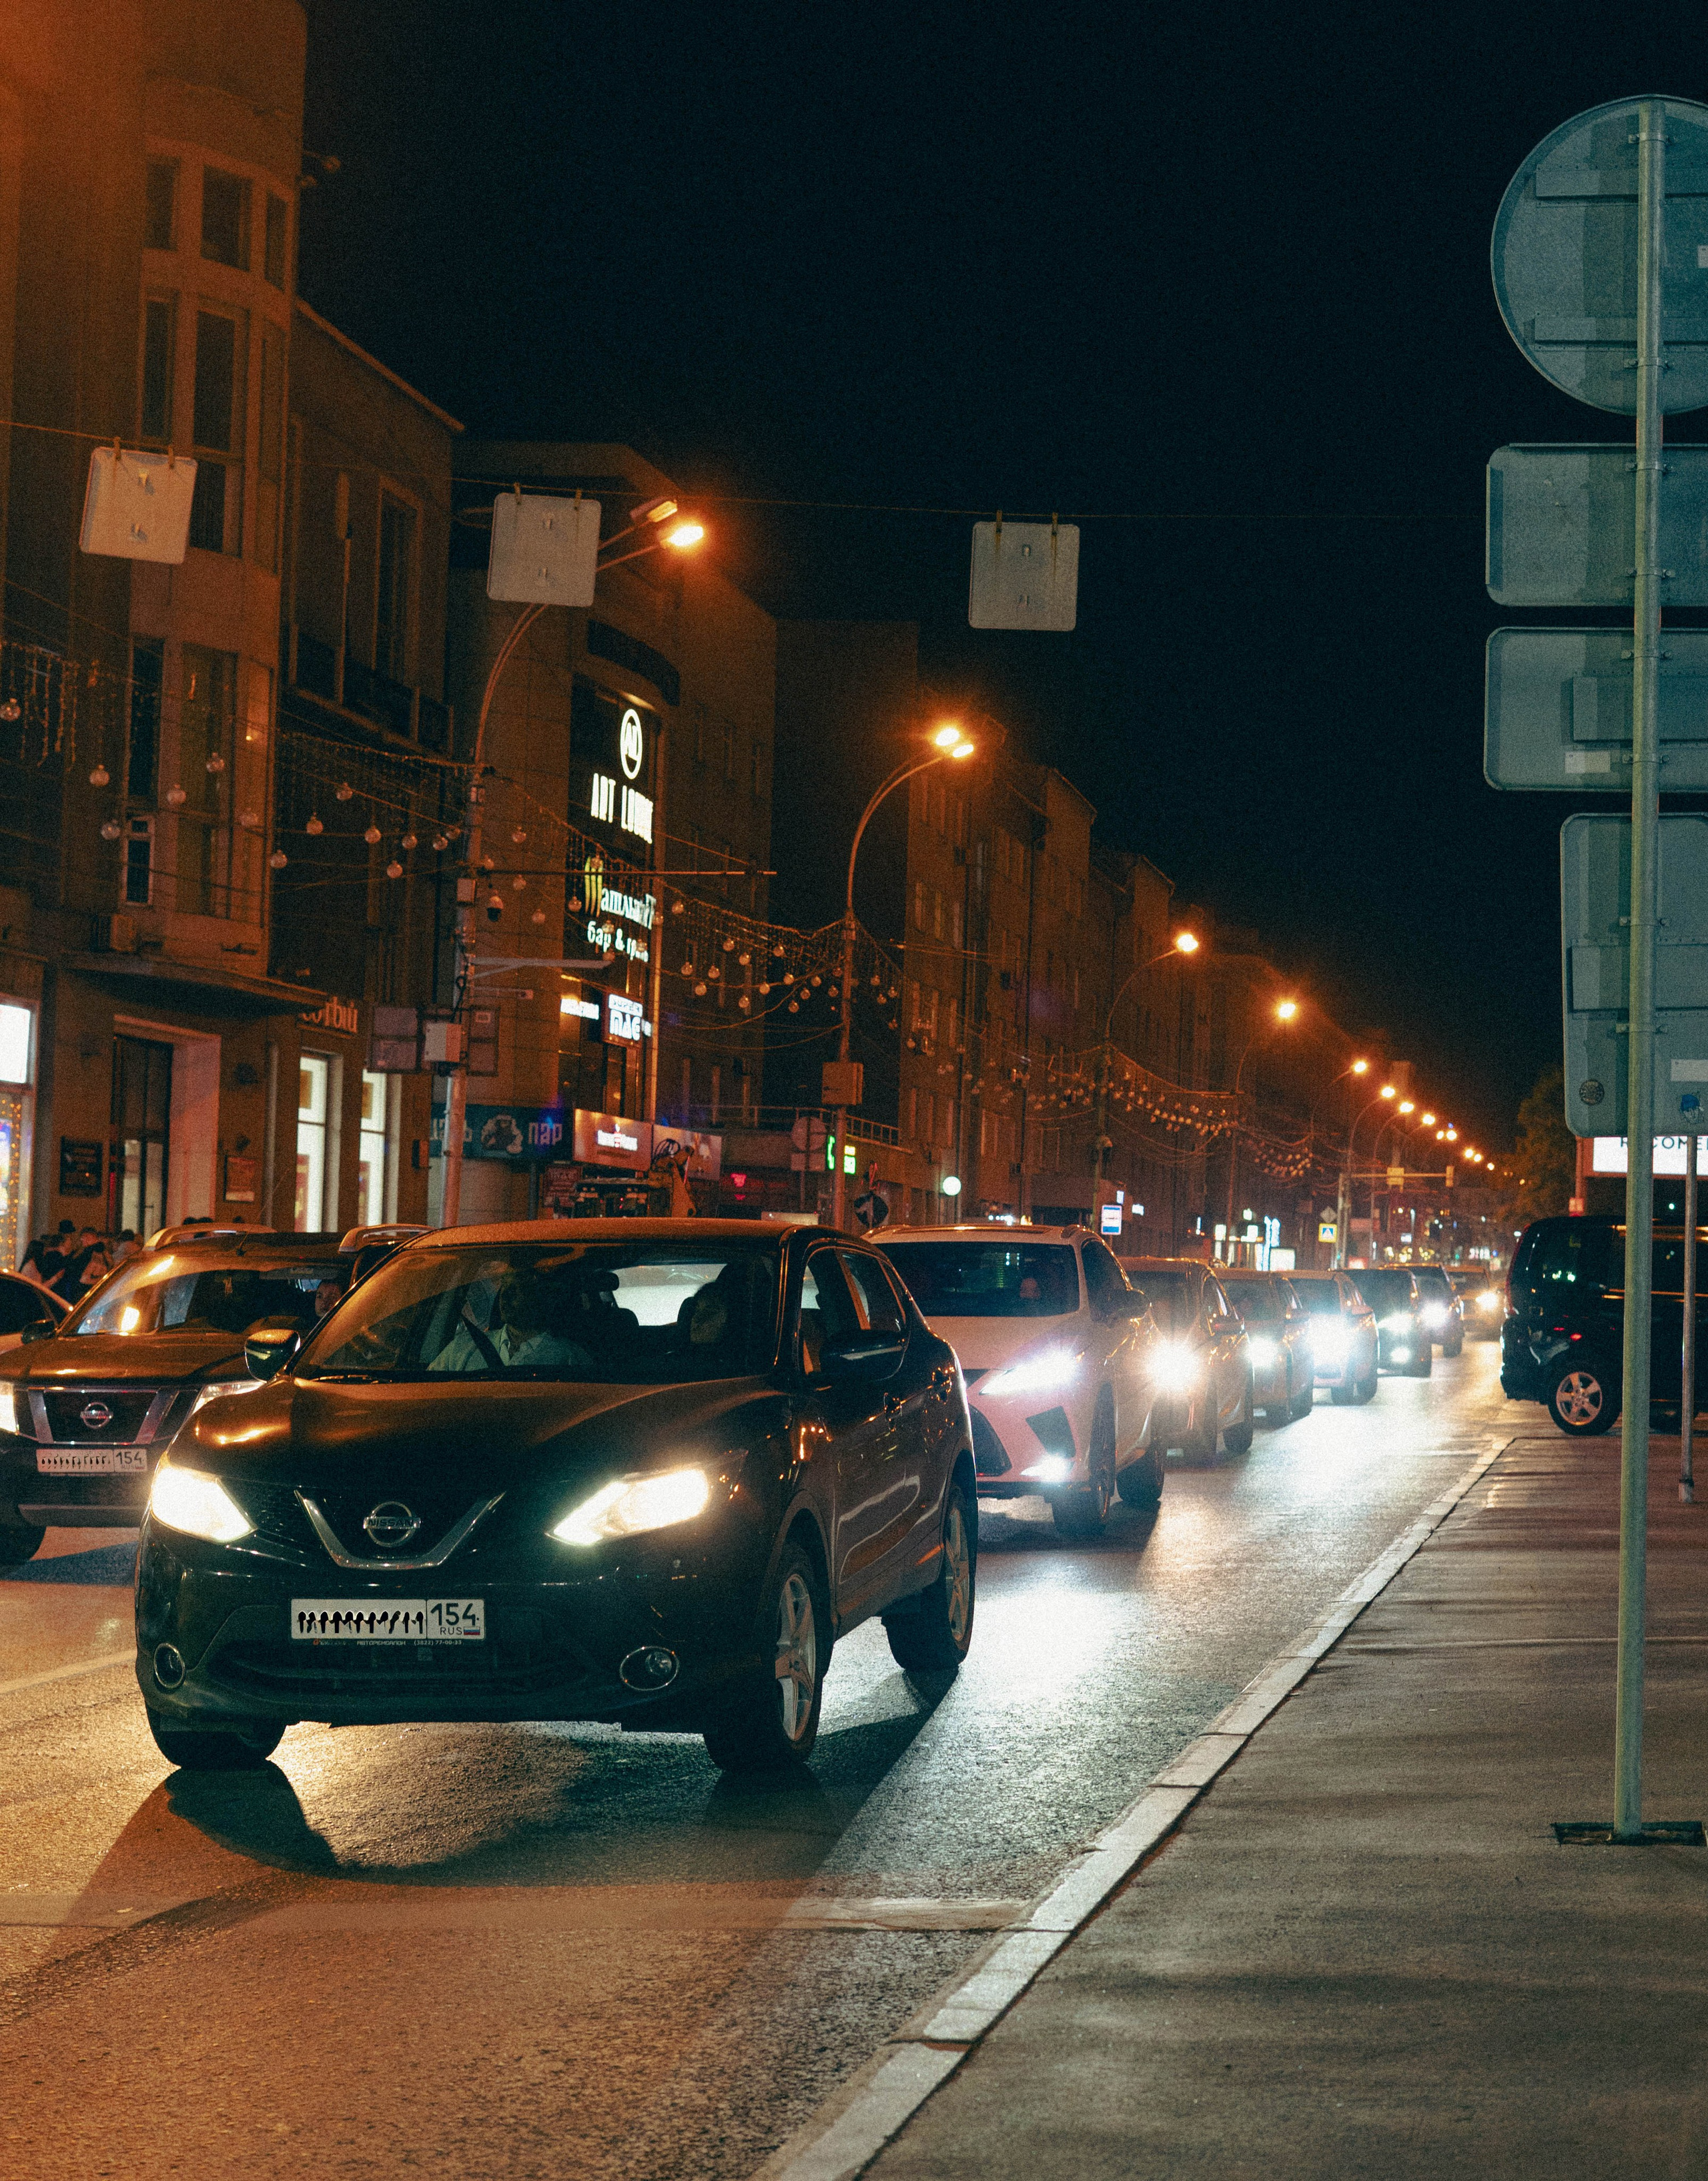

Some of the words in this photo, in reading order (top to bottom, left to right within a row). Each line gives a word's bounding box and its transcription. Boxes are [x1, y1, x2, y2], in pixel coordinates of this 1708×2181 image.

[590, 773, 616, 823] ART
[115, 1452, 142, 1464] 154
[368, 1518, 414, 1528] NISSAN
[430, 1602, 476, 1626] 154
[440, 1626, 462, 1636] RUS
